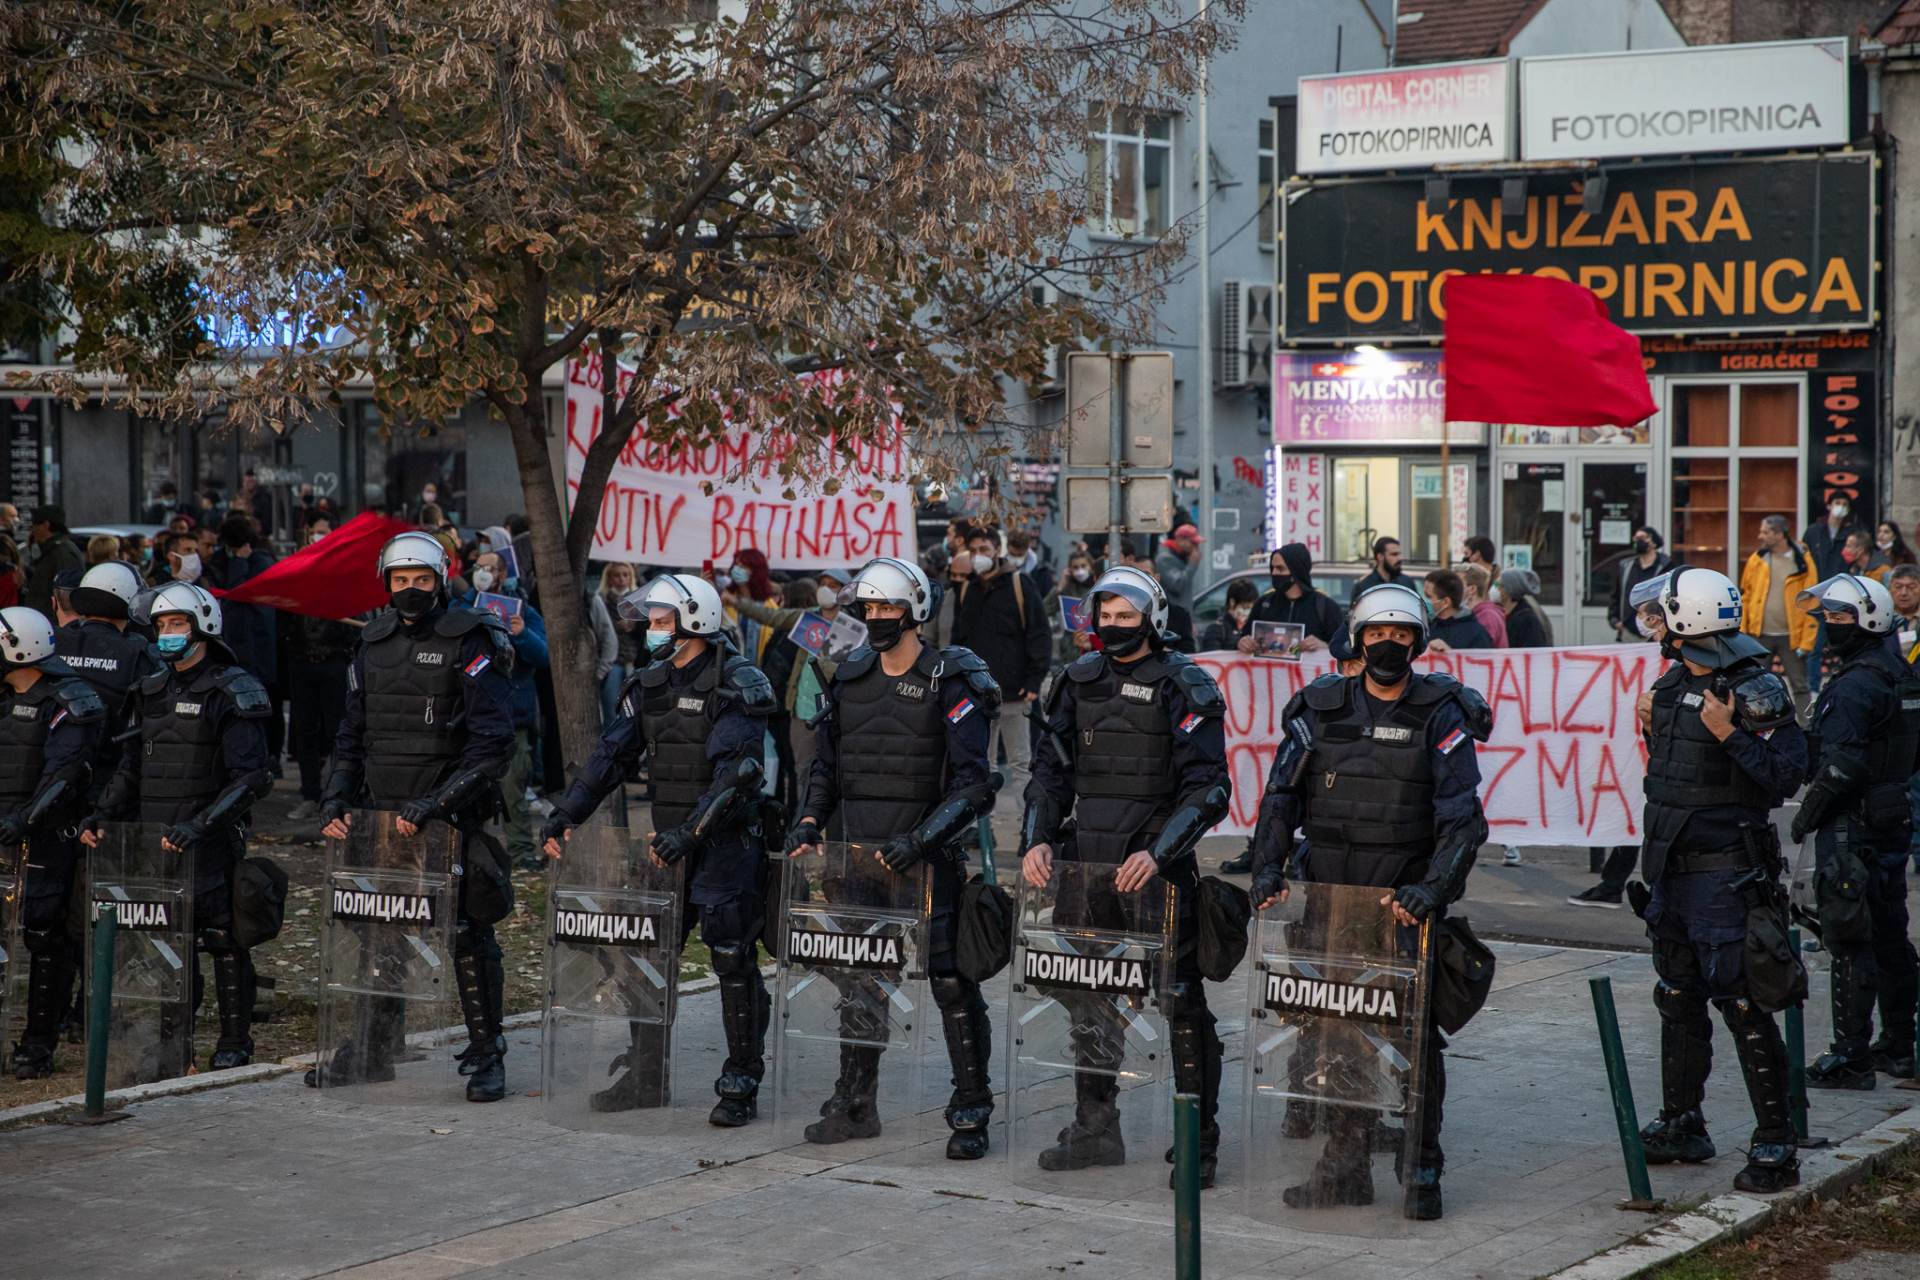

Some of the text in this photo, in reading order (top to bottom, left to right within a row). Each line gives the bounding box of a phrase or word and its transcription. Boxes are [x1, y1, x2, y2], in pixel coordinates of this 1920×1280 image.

[1322, 74, 1492, 109] DIGITAL CORNER
[1319, 122, 1494, 157] FOTOKOPIRNICA
[1551, 102, 1822, 142] FOTOKOPIRNICA
[1306, 256, 1864, 325] FOTPIRNICA
[1720, 350, 1819, 370] IGRAČKE
[1395, 402, 1446, 415] OFFIC
[1285, 456, 1300, 545] MENJ
[711, 483, 903, 560] BATINAŠA
[333, 890, 432, 922] ПОЛИЦИЈА
[556, 911, 656, 943] ПОЛИЦИЈА
[791, 931, 899, 965] ПОЛИЦИЈА
[1026, 952, 1145, 989] ПОЛИЦИЈА
[1267, 975, 1398, 1018] ПОЛИЦИЈА
